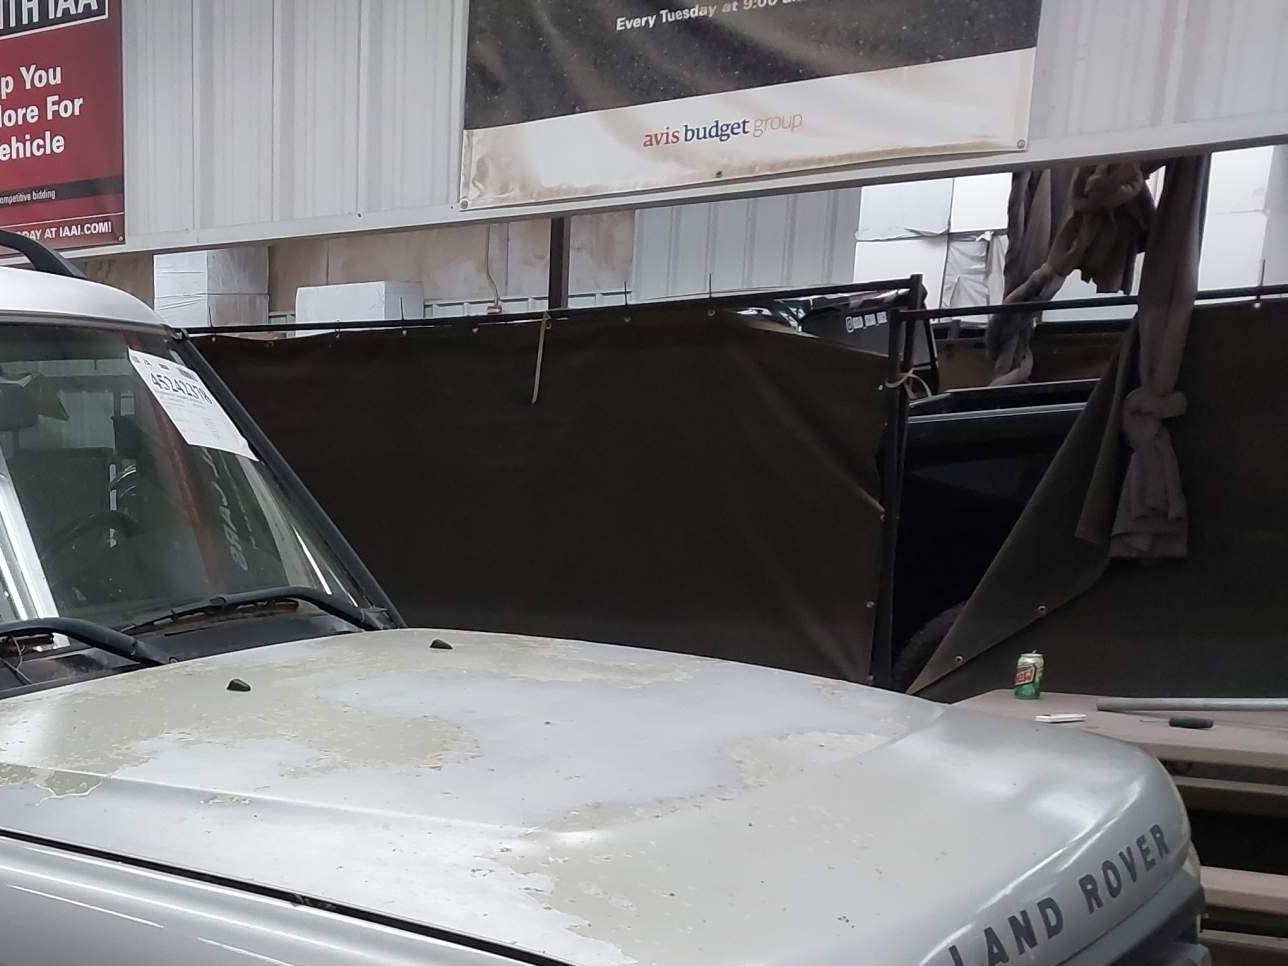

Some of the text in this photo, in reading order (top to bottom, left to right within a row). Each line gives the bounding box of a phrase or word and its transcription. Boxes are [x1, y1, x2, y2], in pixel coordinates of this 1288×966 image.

[615, 14, 656, 31] Every
[659, 4, 716, 23] Tuesday
[722, 1, 738, 13] at
[19, 64, 62, 90] You
[46, 95, 84, 120] For
[643, 114, 803, 147] avis budget group
[32, 189, 56, 201] bidding
[44, 228, 57, 239] AT
[60, 221, 112, 238] IAAI.COM!
[1079, 824, 1168, 915] ROVER
